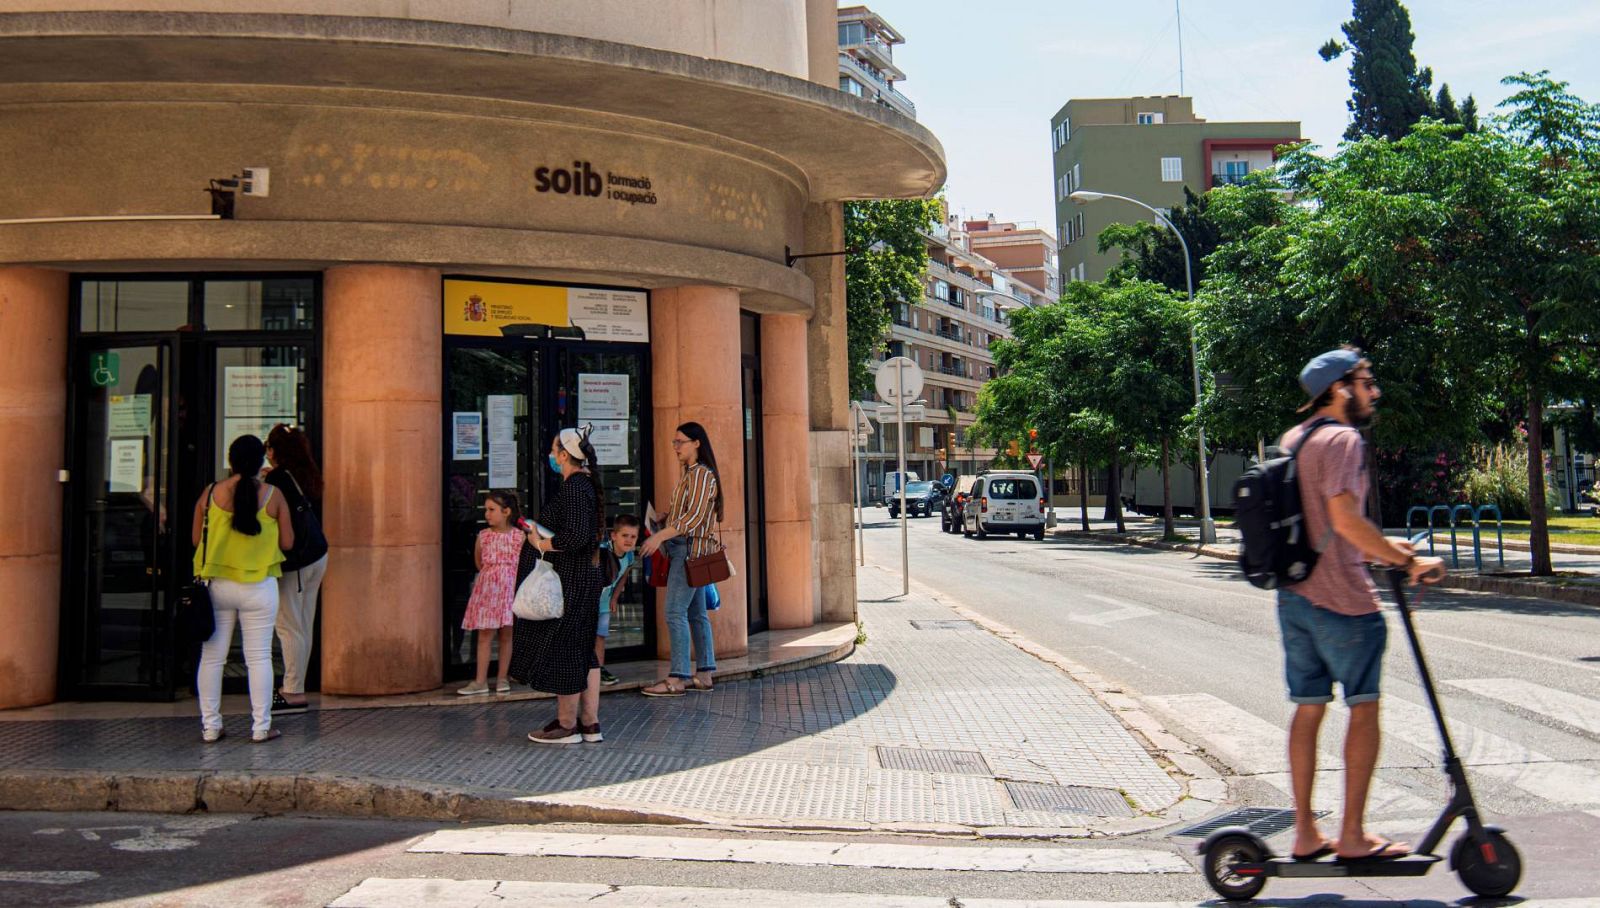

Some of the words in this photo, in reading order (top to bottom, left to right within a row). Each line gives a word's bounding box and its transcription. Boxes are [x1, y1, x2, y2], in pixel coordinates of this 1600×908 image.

[534, 160, 603, 197] soib
[607, 171, 651, 189] formació
[613, 190, 657, 205] ocupació
